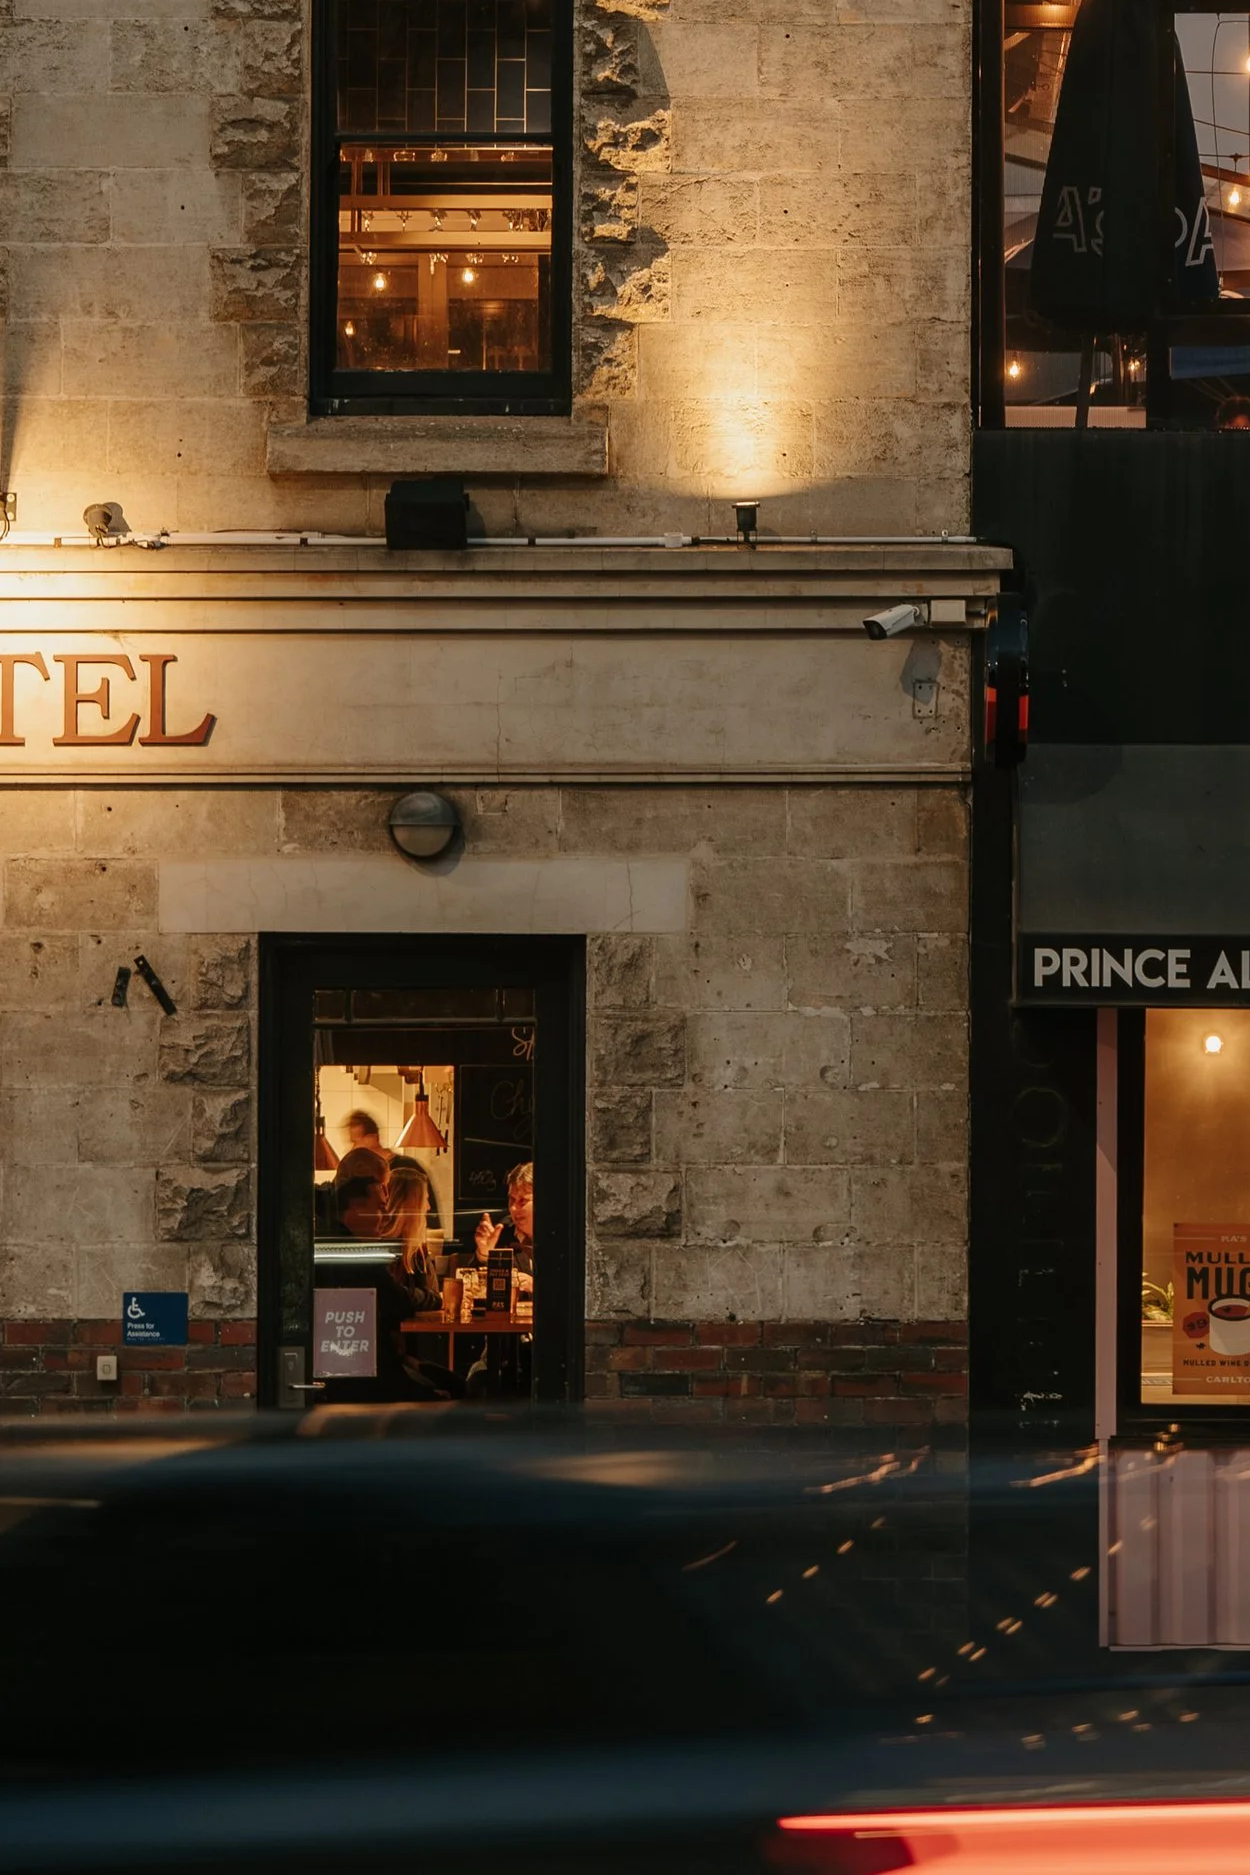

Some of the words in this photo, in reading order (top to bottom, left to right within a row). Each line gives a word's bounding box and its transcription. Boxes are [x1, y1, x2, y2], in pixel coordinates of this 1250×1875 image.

[0, 652, 217, 746] TEL
[1034, 948, 1191, 987] PRINCE
[324, 1311, 365, 1325] PUSH
[127, 1322, 145, 1330] Press
[145, 1322, 155, 1330] for
[336, 1325, 355, 1339] TO
[127, 1330, 160, 1338] Assistance
[320, 1339, 369, 1356] ENTER
[1183, 1359, 1217, 1367] MULLED
[1219, 1359, 1241, 1367] WINE
